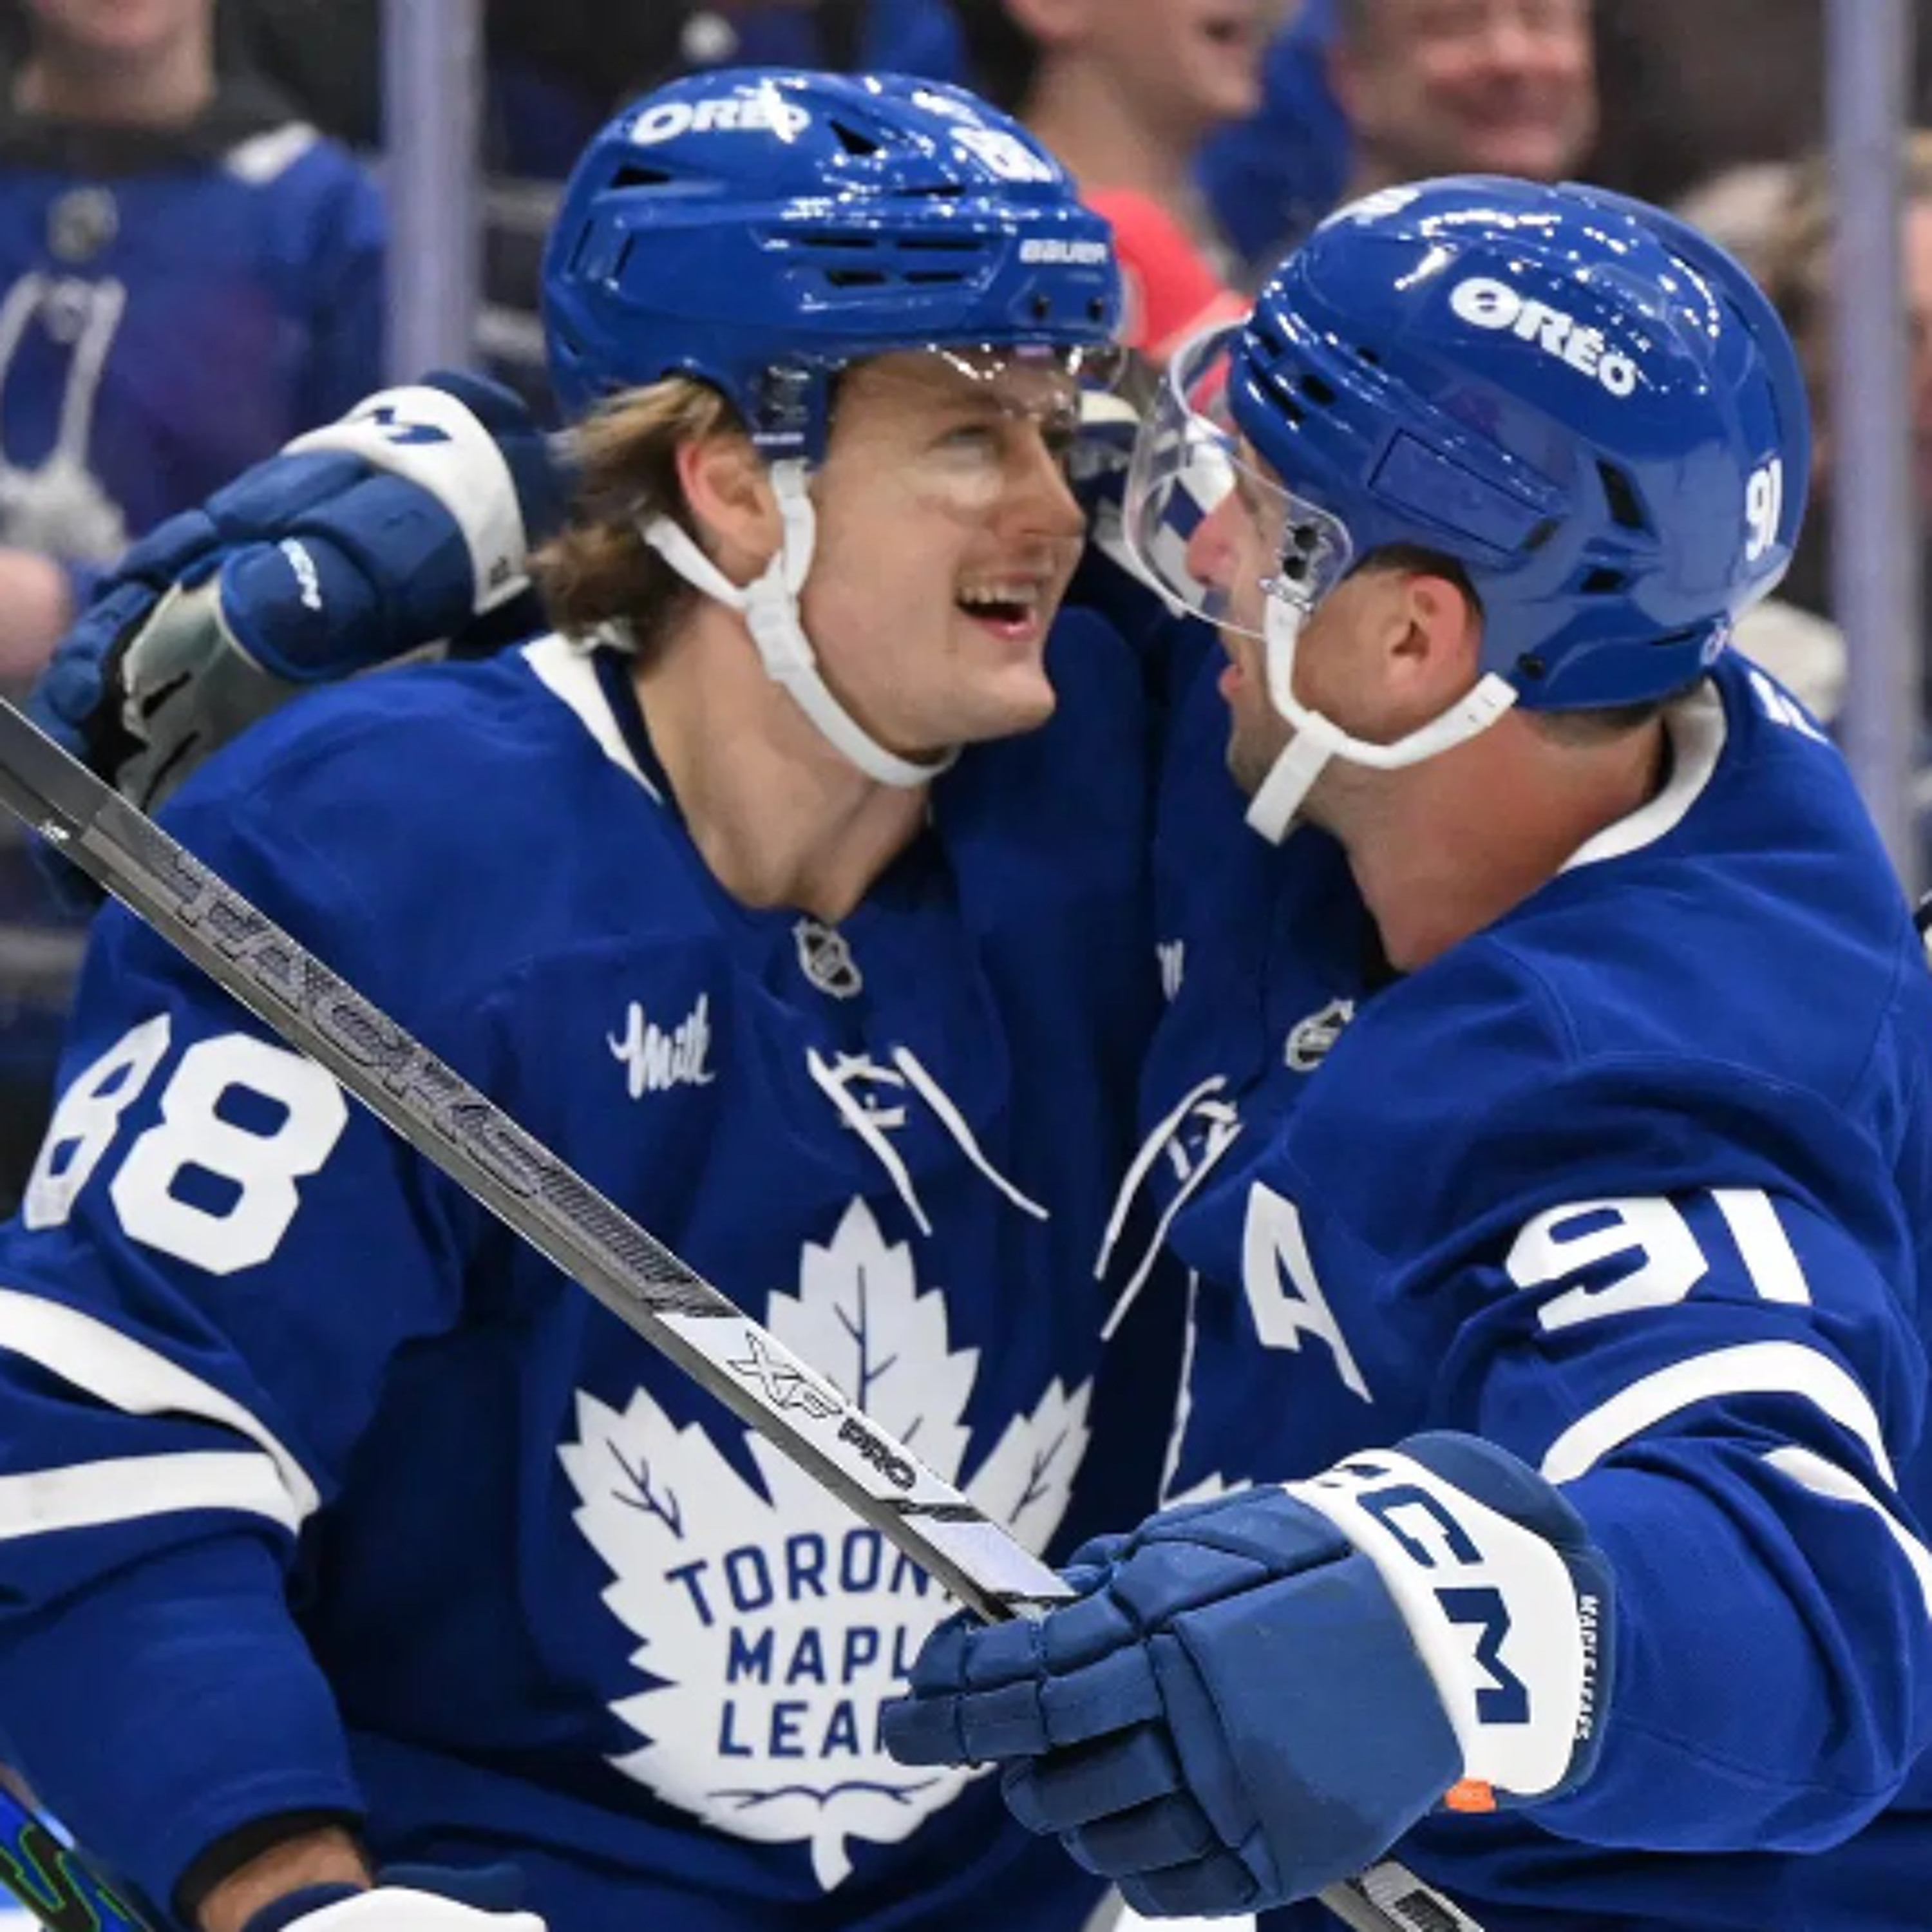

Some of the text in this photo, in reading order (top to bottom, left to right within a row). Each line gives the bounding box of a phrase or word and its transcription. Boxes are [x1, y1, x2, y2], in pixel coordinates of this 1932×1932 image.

[1448, 275, 1636, 397] OREO
[1745, 456, 1783, 562] 91
[23, 1013, 350, 1275] 88
[1242, 1180, 1373, 1403] A
[1504, 1188, 1812, 1331] 91
[838, 1417, 917, 1492] PRO
[665, 1528, 933, 1627] TORON
[726, 1625, 917, 1683] MAPL
[717, 1696, 909, 1757] LEA
